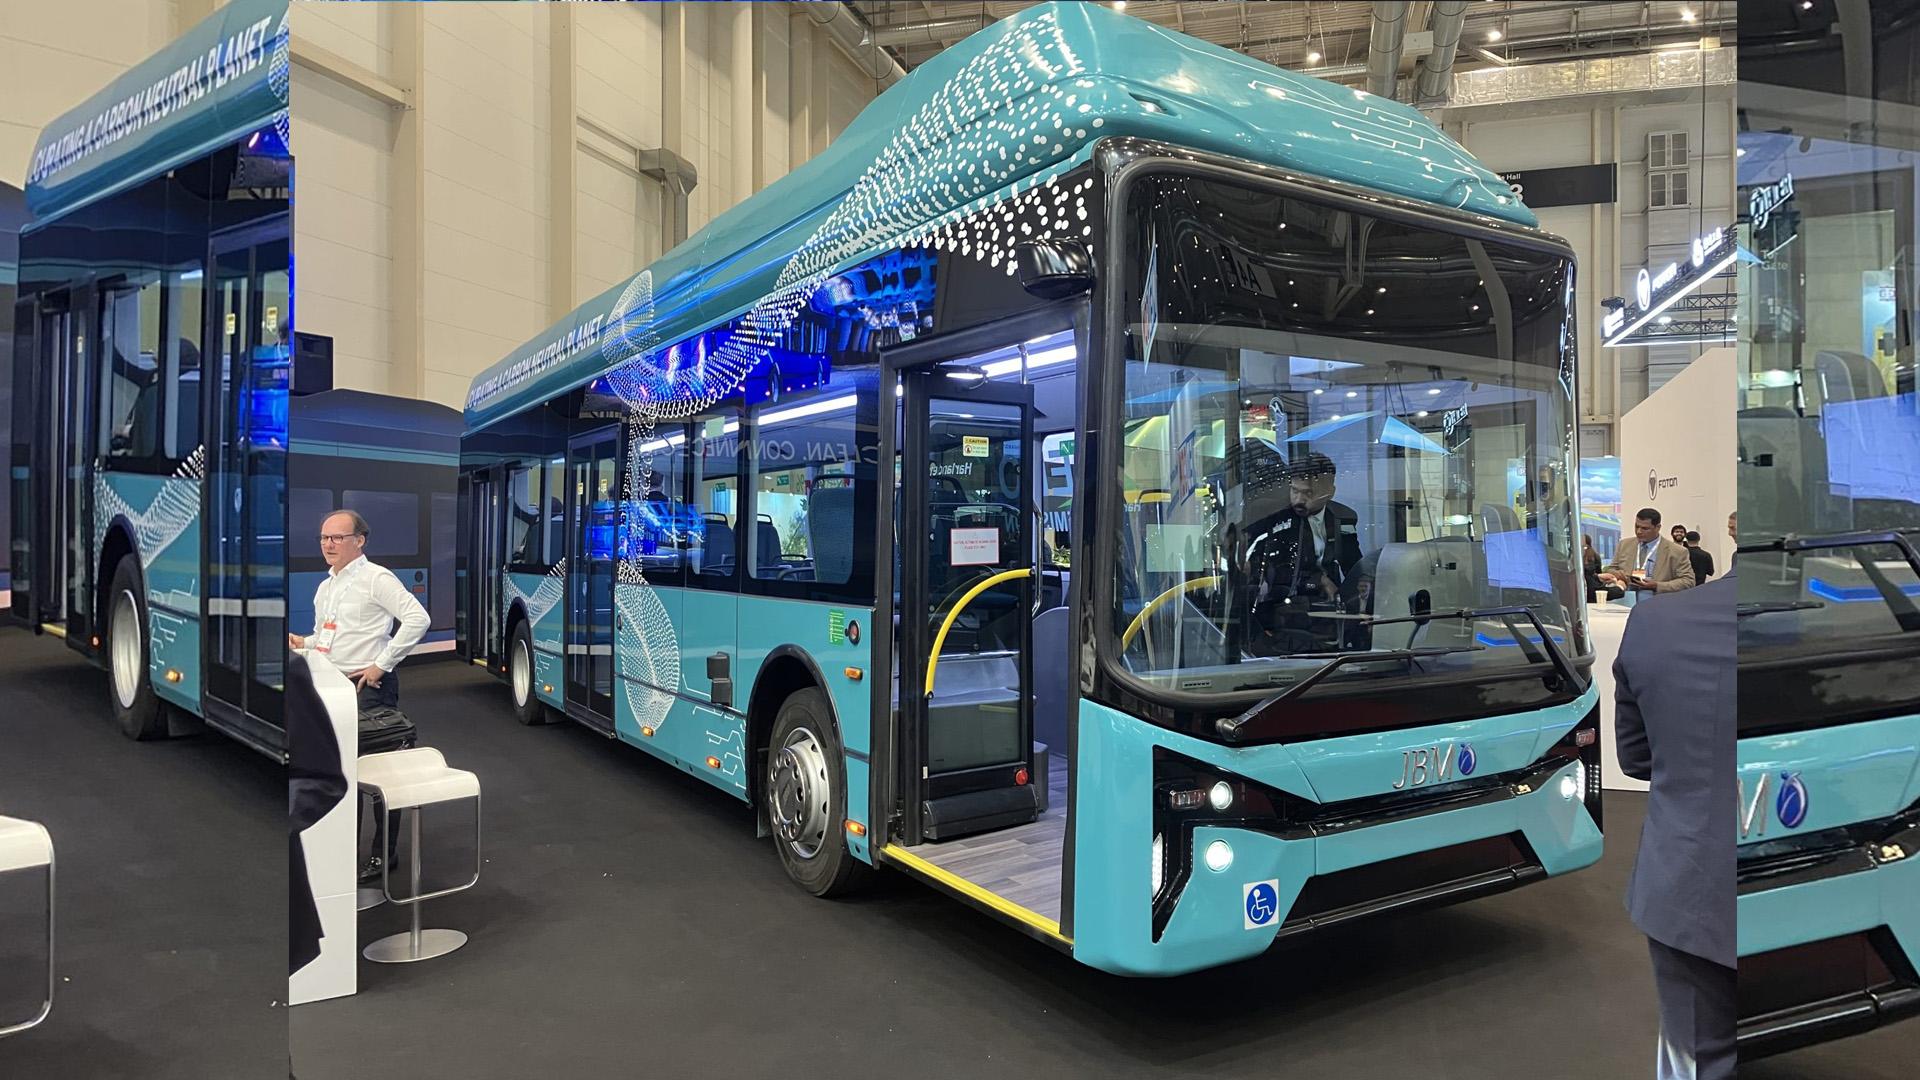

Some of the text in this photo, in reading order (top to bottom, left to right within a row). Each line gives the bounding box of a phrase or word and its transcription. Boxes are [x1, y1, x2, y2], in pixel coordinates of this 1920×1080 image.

[93, 90, 145, 151] CARBON
[144, 55, 205, 127] NEUTRAL
[206, 15, 272, 94] PLANET
[1506, 172, 1521, 180] Hall
[502, 356, 533, 391] CARBON
[531, 335, 566, 377] NEUTRAL
[567, 313, 605, 359] PLANET
[1658, 476, 1678, 489] FOTON
[1392, 743, 1455, 790] JBM
